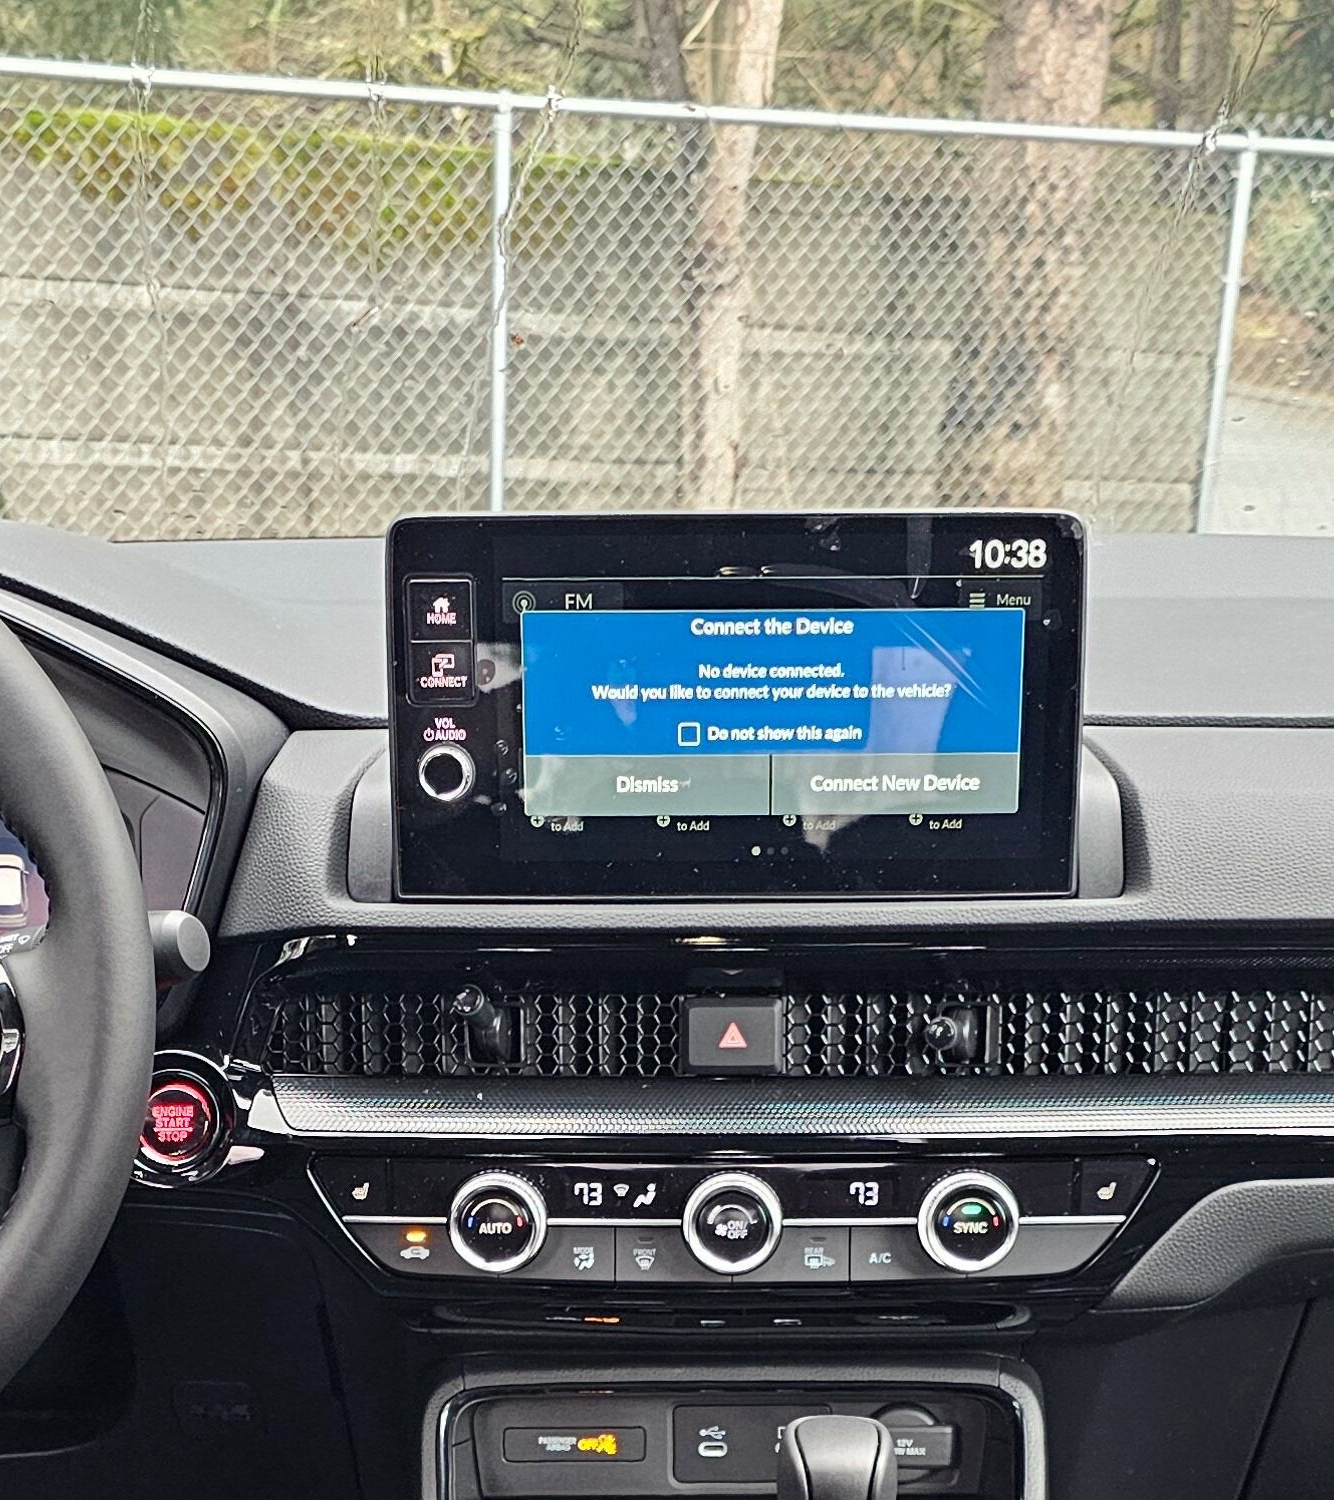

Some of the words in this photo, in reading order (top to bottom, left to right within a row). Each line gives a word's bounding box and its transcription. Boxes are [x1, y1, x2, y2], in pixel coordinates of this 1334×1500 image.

[969, 539, 1047, 568] 10:38
[565, 593, 592, 609] FM
[996, 594, 1031, 606] Menu
[427, 613, 456, 625] HOME
[691, 619, 760, 635] Connect
[764, 618, 792, 634] the
[797, 618, 853, 634] Device
[699, 665, 720, 678] No
[723, 664, 767, 678] device
[770, 664, 843, 678] connected.
[420, 677, 467, 688] CONNECT
[592, 685, 638, 699] Would
[641, 688, 666, 701] you
[670, 685, 693, 699] like
[696, 686, 711, 699] to
[714, 686, 769, 699] connect
[772, 688, 803, 700] your
[806, 684, 850, 698] device
[853, 685, 868, 698] to
[871, 684, 895, 698] the
[897, 684, 951, 697] vehicle?
[435, 718, 456, 729] VOL
[434, 729, 466, 741] AUDIO
[708, 727, 728, 740] Do
[731, 729, 754, 740] not
[757, 727, 794, 740] show
[797, 726, 822, 740] this
[825, 727, 861, 742] again
[617, 776, 678, 792] Dismiss
[811, 776, 878, 791] Connect
[883, 775, 920, 790] New
[924, 775, 980, 790] Device
[551, 820, 561, 831] to
[563, 820, 583, 832] Add
[677, 820, 686, 831] to
[688, 820, 710, 831] Add
[803, 821, 814, 830] to
[815, 820, 835, 830] Add
[929, 820, 940, 830] to
[942, 819, 962, 830] Add
[152, 1105, 193, 1117] ENGINE
[155, 1117, 190, 1127] START
[158, 1130, 187, 1142] STOP
[574, 1182, 603, 1206] 73
[849, 1182, 879, 1206] 73
[479, 1222, 512, 1235] AUTO
[953, 1222, 989, 1235] SYNC
[727, 1230, 748, 1240] OFF
[633, 1247, 656, 1257] FRONT
[868, 1252, 892, 1264] A/C
